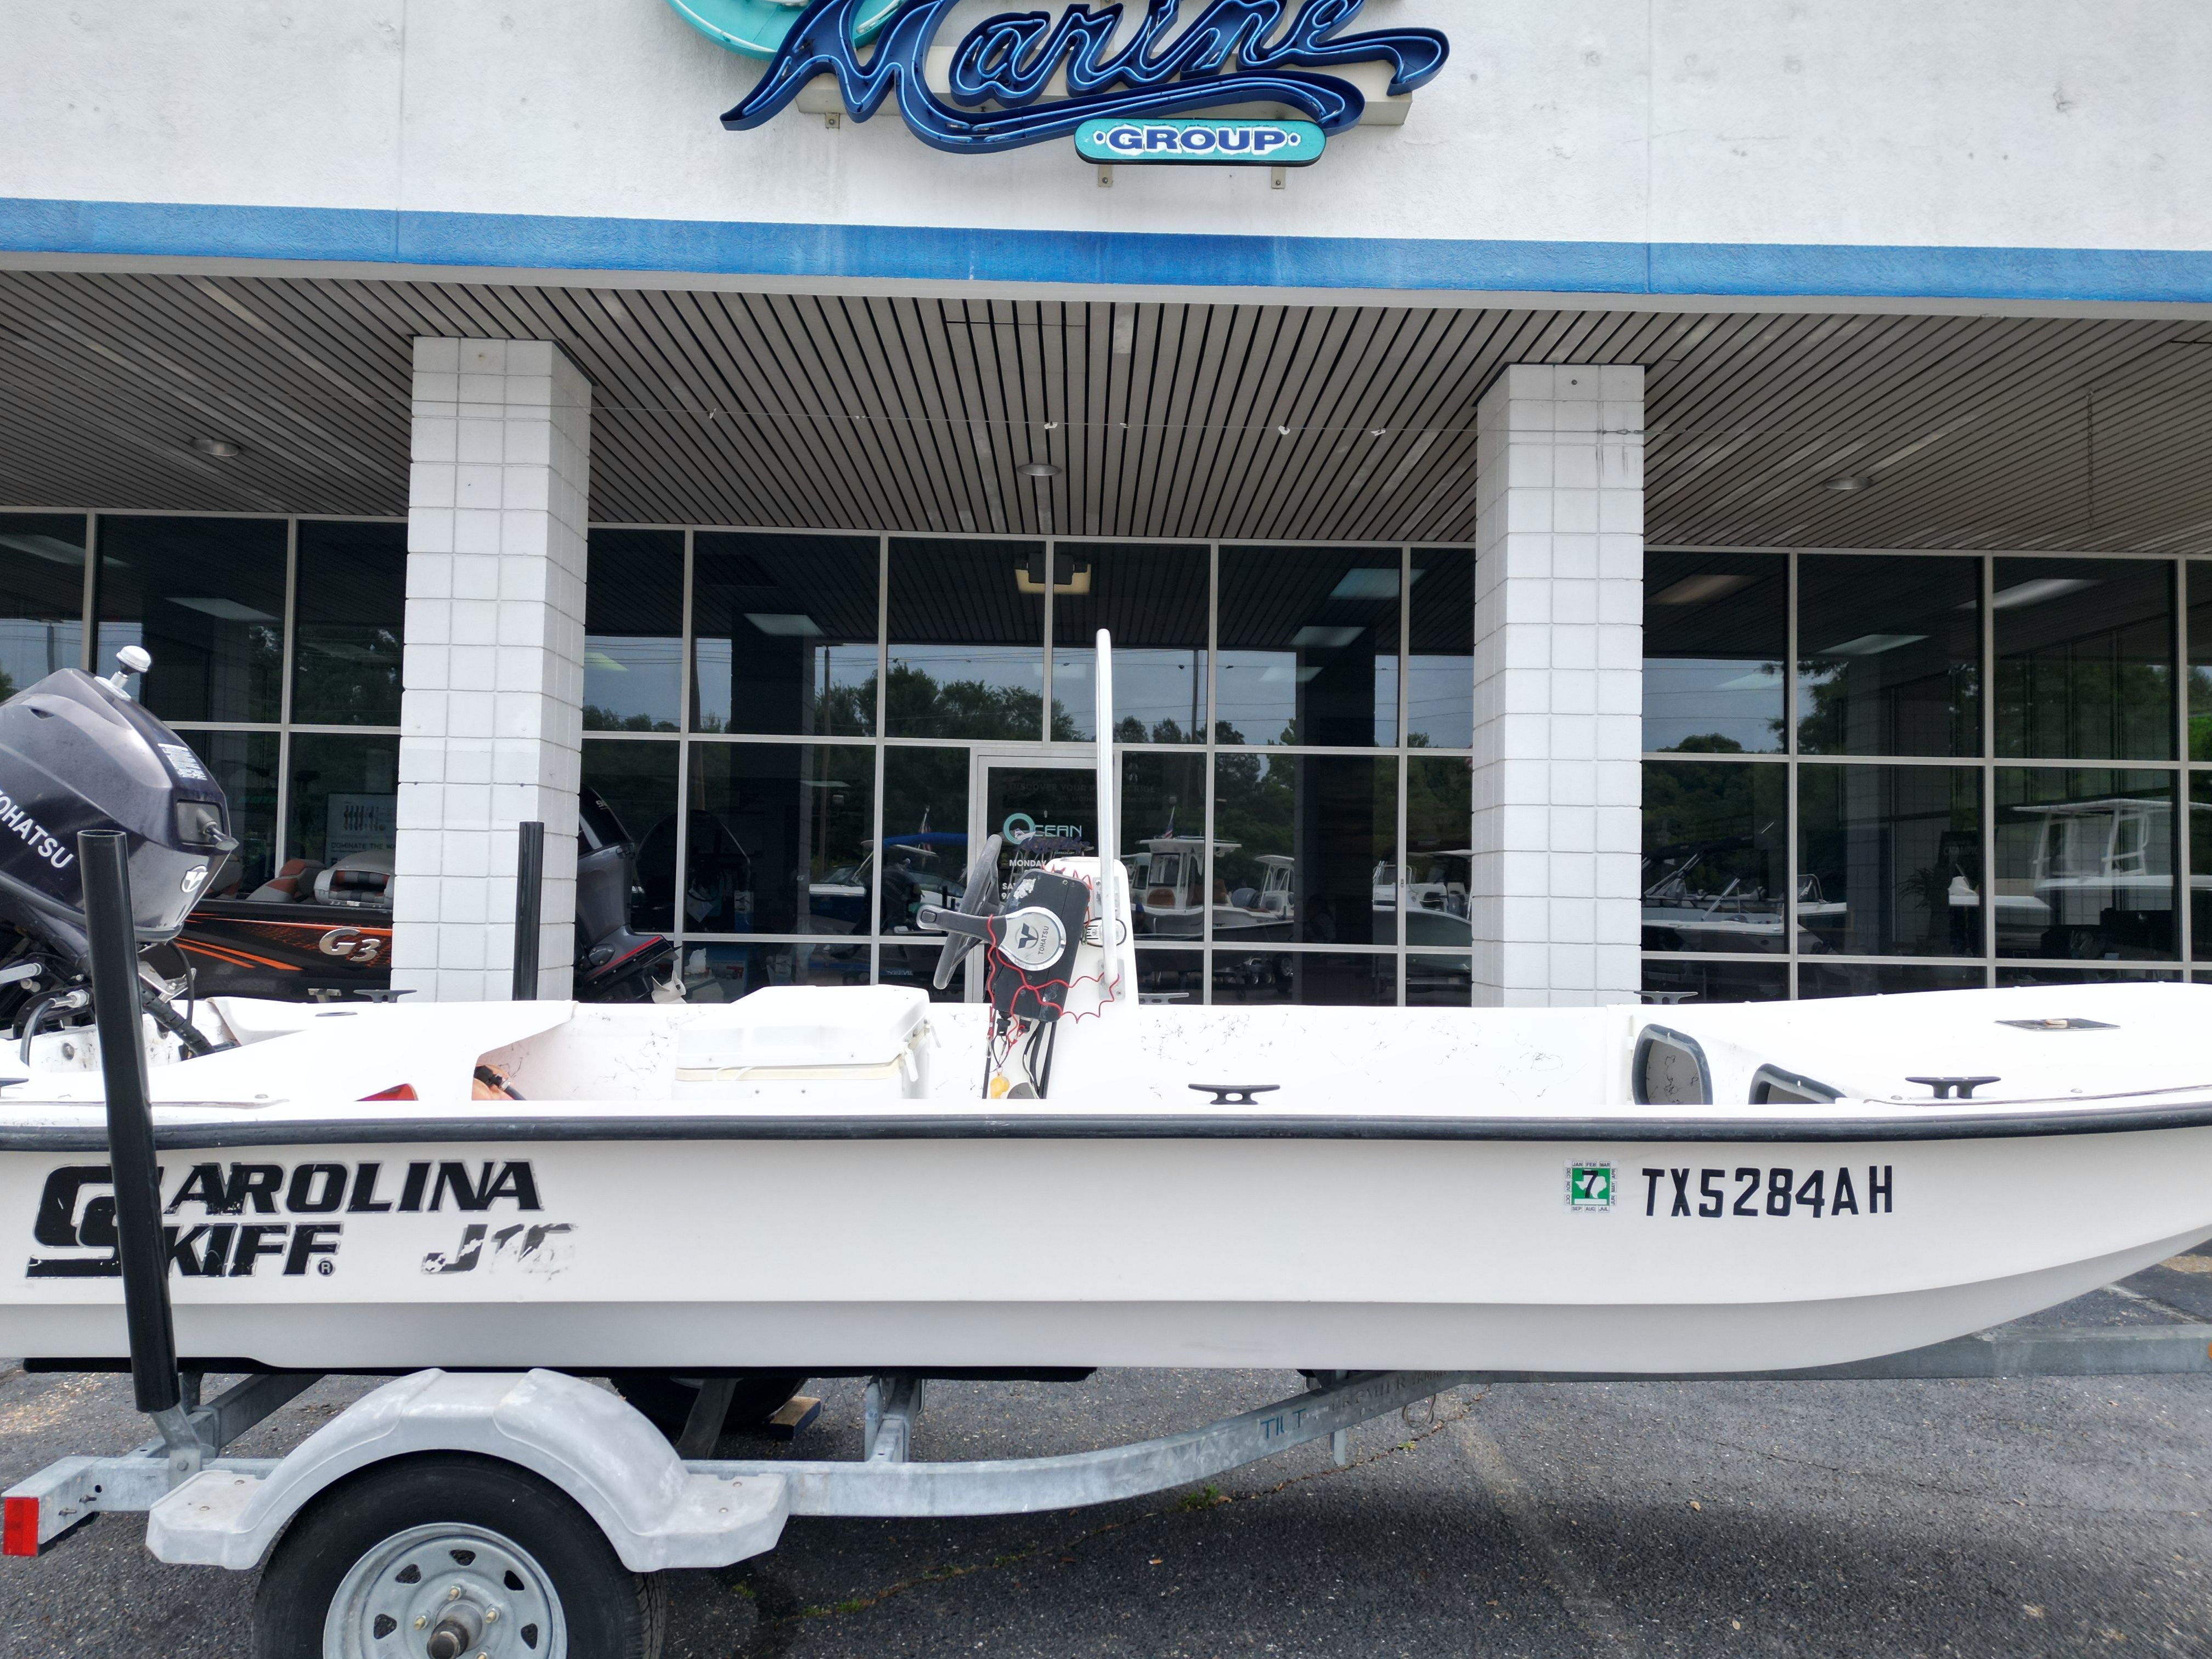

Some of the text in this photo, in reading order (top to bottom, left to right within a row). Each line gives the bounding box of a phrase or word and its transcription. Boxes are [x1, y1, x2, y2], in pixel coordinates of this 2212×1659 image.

[720, 0, 1450, 154] Marine
[1108, 127, 1287, 151] GROUP
[0, 790, 74, 868] OHATSU
[1003, 813, 1082, 845] OCEAN
[331, 842, 367, 850] DOMINATE
[318, 928, 381, 962] G3
[1038, 926, 1049, 955] TOHATSU
[1582, 1170, 1599, 1198] 7
[1642, 1165, 1893, 1219] TX5284AH
[33, 1159, 544, 1247] CAROLINA
[1260, 1408, 1307, 1440] TILT
